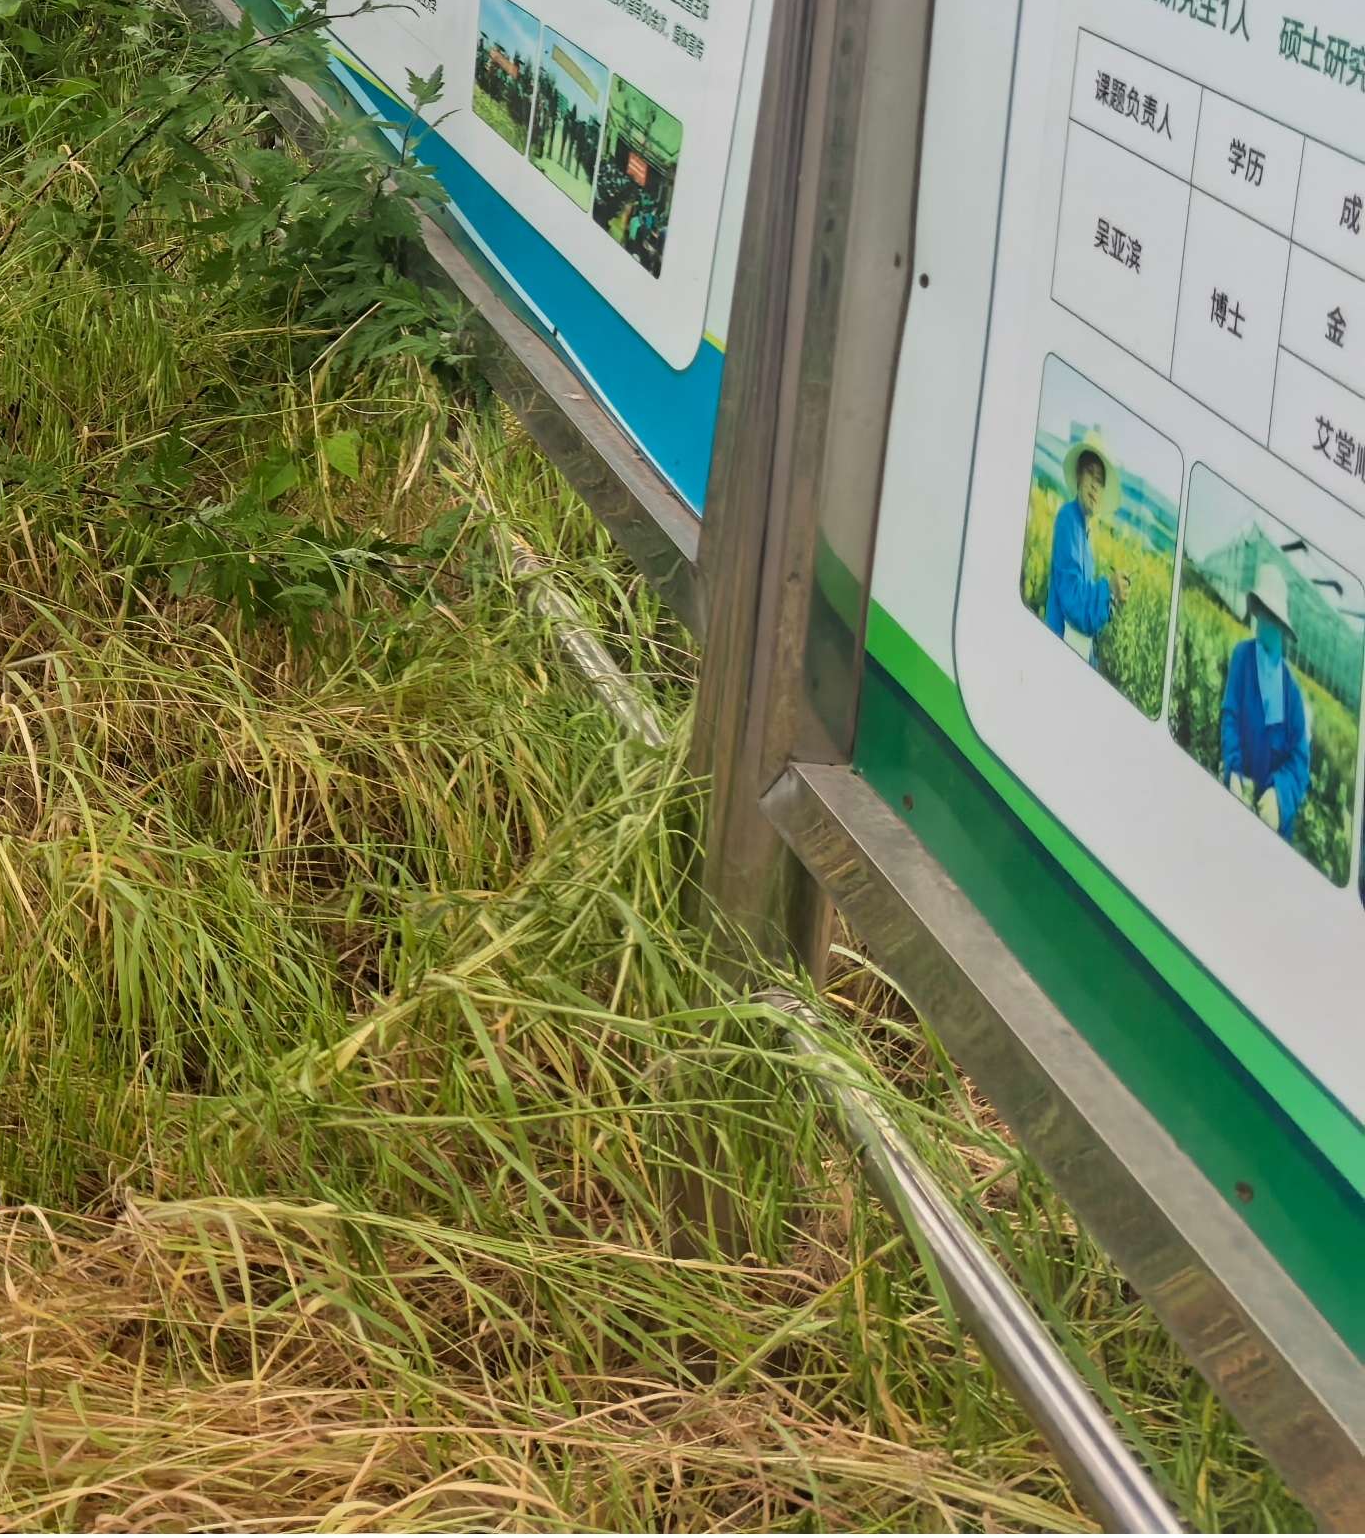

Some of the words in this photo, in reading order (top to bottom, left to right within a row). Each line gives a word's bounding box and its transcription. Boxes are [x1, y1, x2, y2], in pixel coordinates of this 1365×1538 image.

[1278, 15, 1365, 94] 硕士研究
[1094, 70, 1173, 141] 课题负责人
[1228, 137, 1266, 187] 学历
[1339, 194, 1364, 236] 成
[1211, 287, 1245, 339] 博士
[1325, 306, 1347, 348] 金
